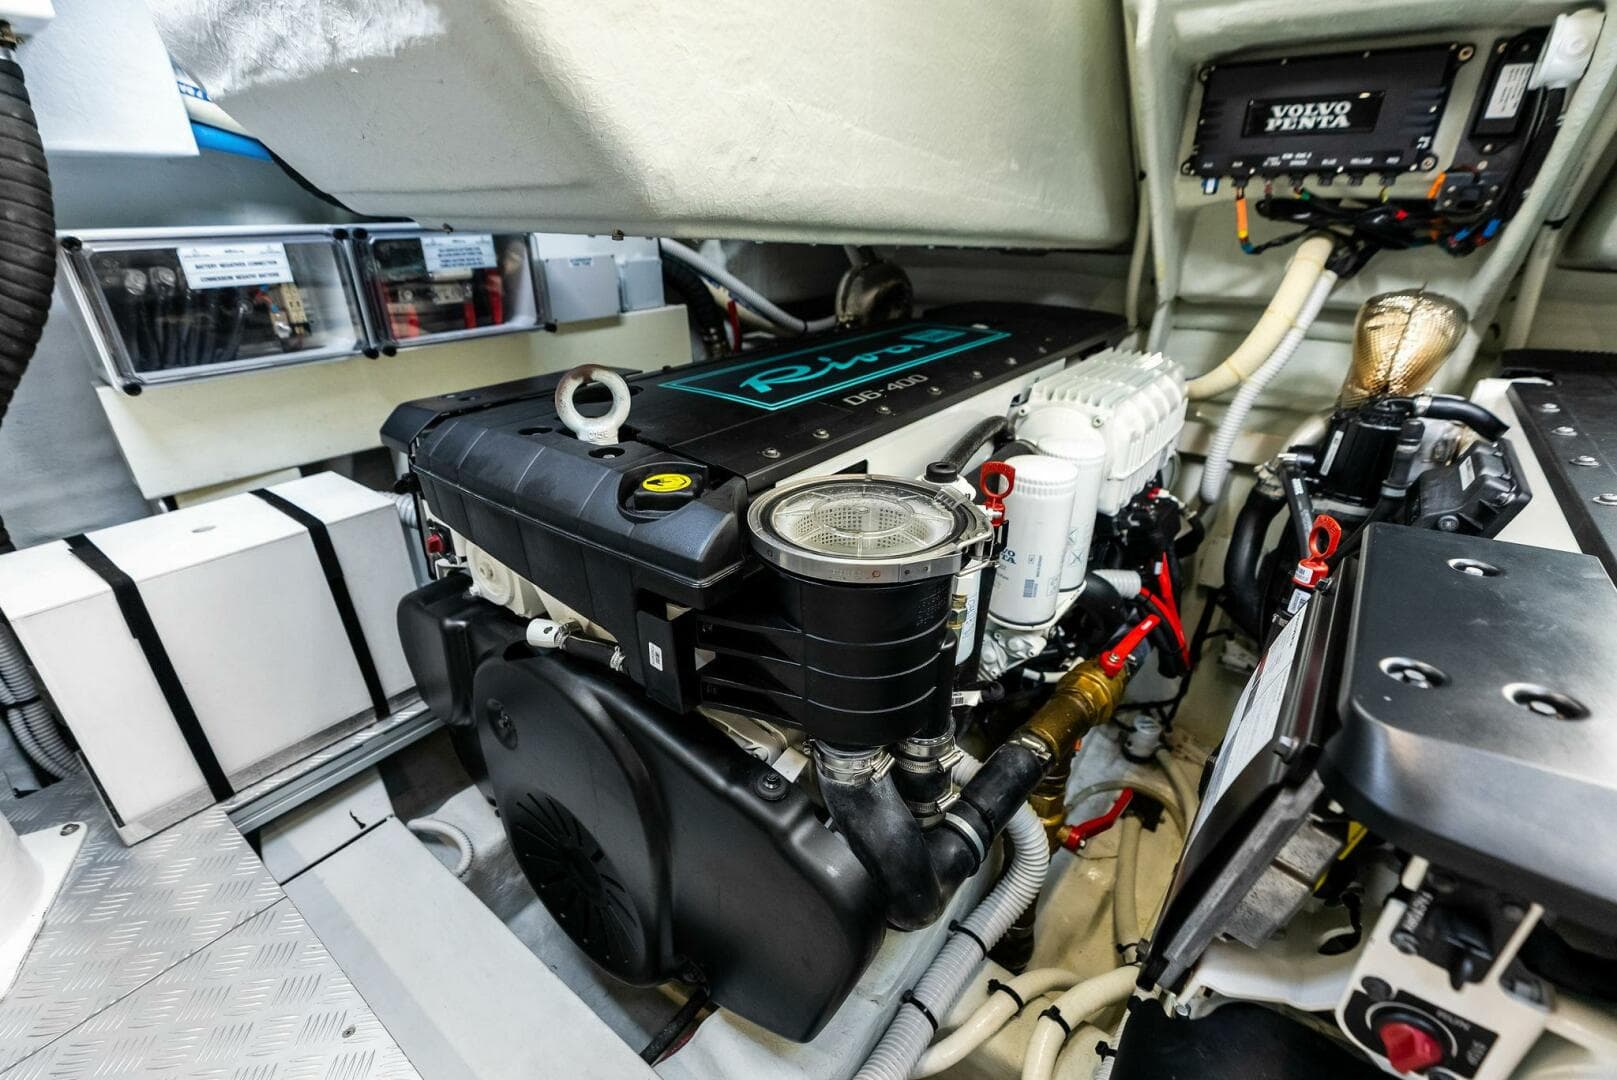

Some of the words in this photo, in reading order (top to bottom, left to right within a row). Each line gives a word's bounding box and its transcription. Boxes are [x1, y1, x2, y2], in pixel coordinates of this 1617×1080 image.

[1270, 100, 1352, 118] VOLVO
[1263, 115, 1351, 132] PENTA
[739, 344, 925, 393] Riva
[842, 374, 929, 406] D6-400
